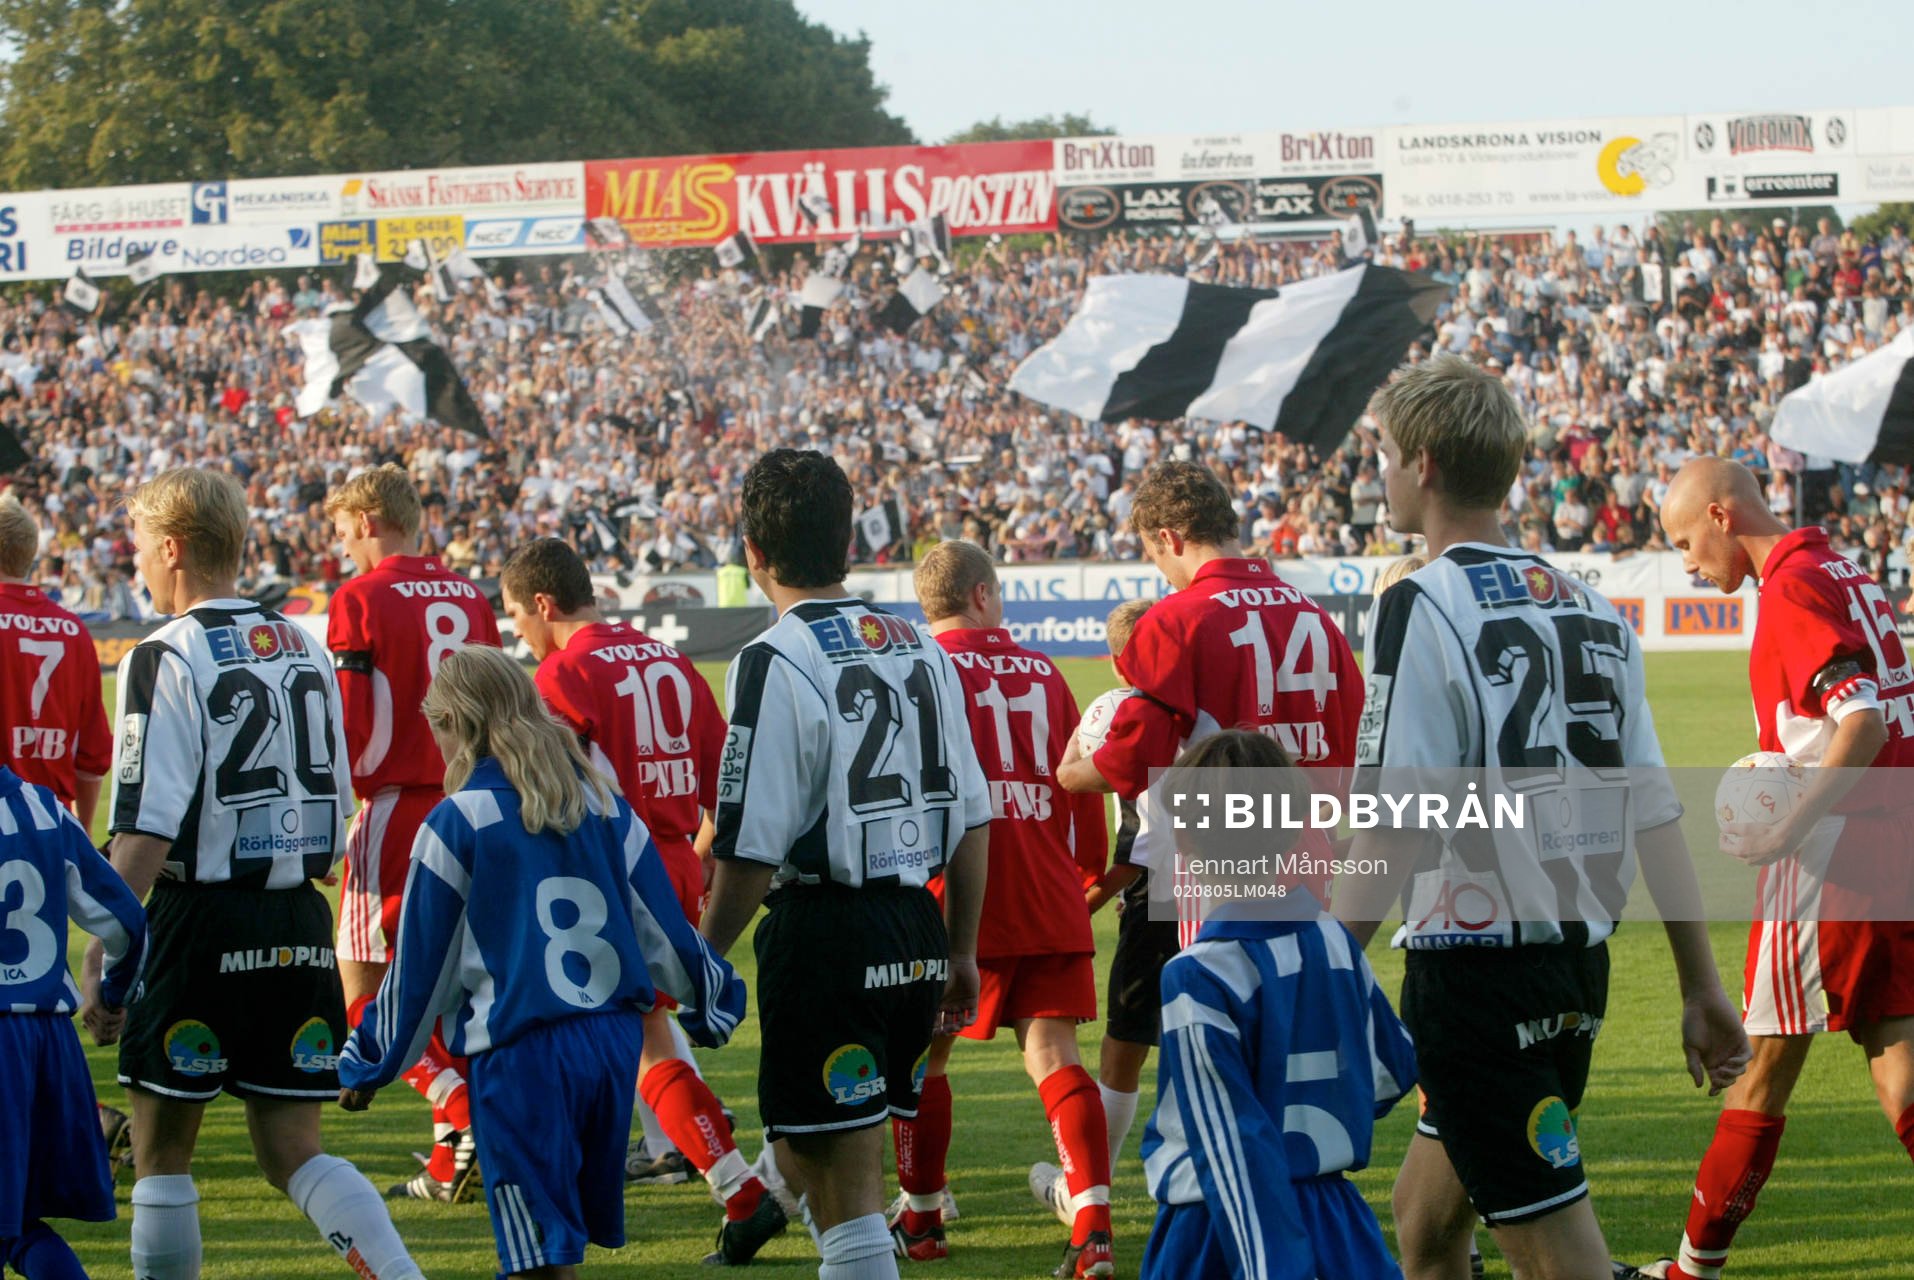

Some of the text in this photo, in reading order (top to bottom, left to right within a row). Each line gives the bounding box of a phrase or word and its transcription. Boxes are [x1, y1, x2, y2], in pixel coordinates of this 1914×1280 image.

[1399, 130, 1602, 151] LANDSKRONA VISION
[1727, 114, 1814, 155] VIDEOMIX
[1063, 142, 1154, 170] BriXton
[1280, 133, 1374, 161] BriXton
[1124, 188, 1182, 207] LAX
[1255, 196, 1314, 216] LAX
[475, 233, 505, 244] NCC
[534, 231, 566, 241] NCC
[182, 246, 286, 267] Nordea
[390, 581, 476, 599] VOLVO
[0, 613, 80, 636] VOLVO
[1671, 603, 1740, 630] PNB
[808, 614, 920, 653] ELON
[590, 643, 680, 663] VOLVO
[950, 652, 1052, 676] VOLVO
[1229, 610, 1338, 716] 14
[18, 637, 65, 720] 7
[614, 661, 692, 756] 10
[1474, 614, 1629, 792] 25
[207, 664, 338, 806] 20
[668, 740, 686, 751] ICA
[835, 659, 957, 814] 21
[239, 832, 329, 854] Rörläggaren
[536, 876, 621, 1009] 8
[4, 968, 28, 980] ICA
[172, 1055, 229, 1074] LSR
[834, 1075, 887, 1106] LSR
